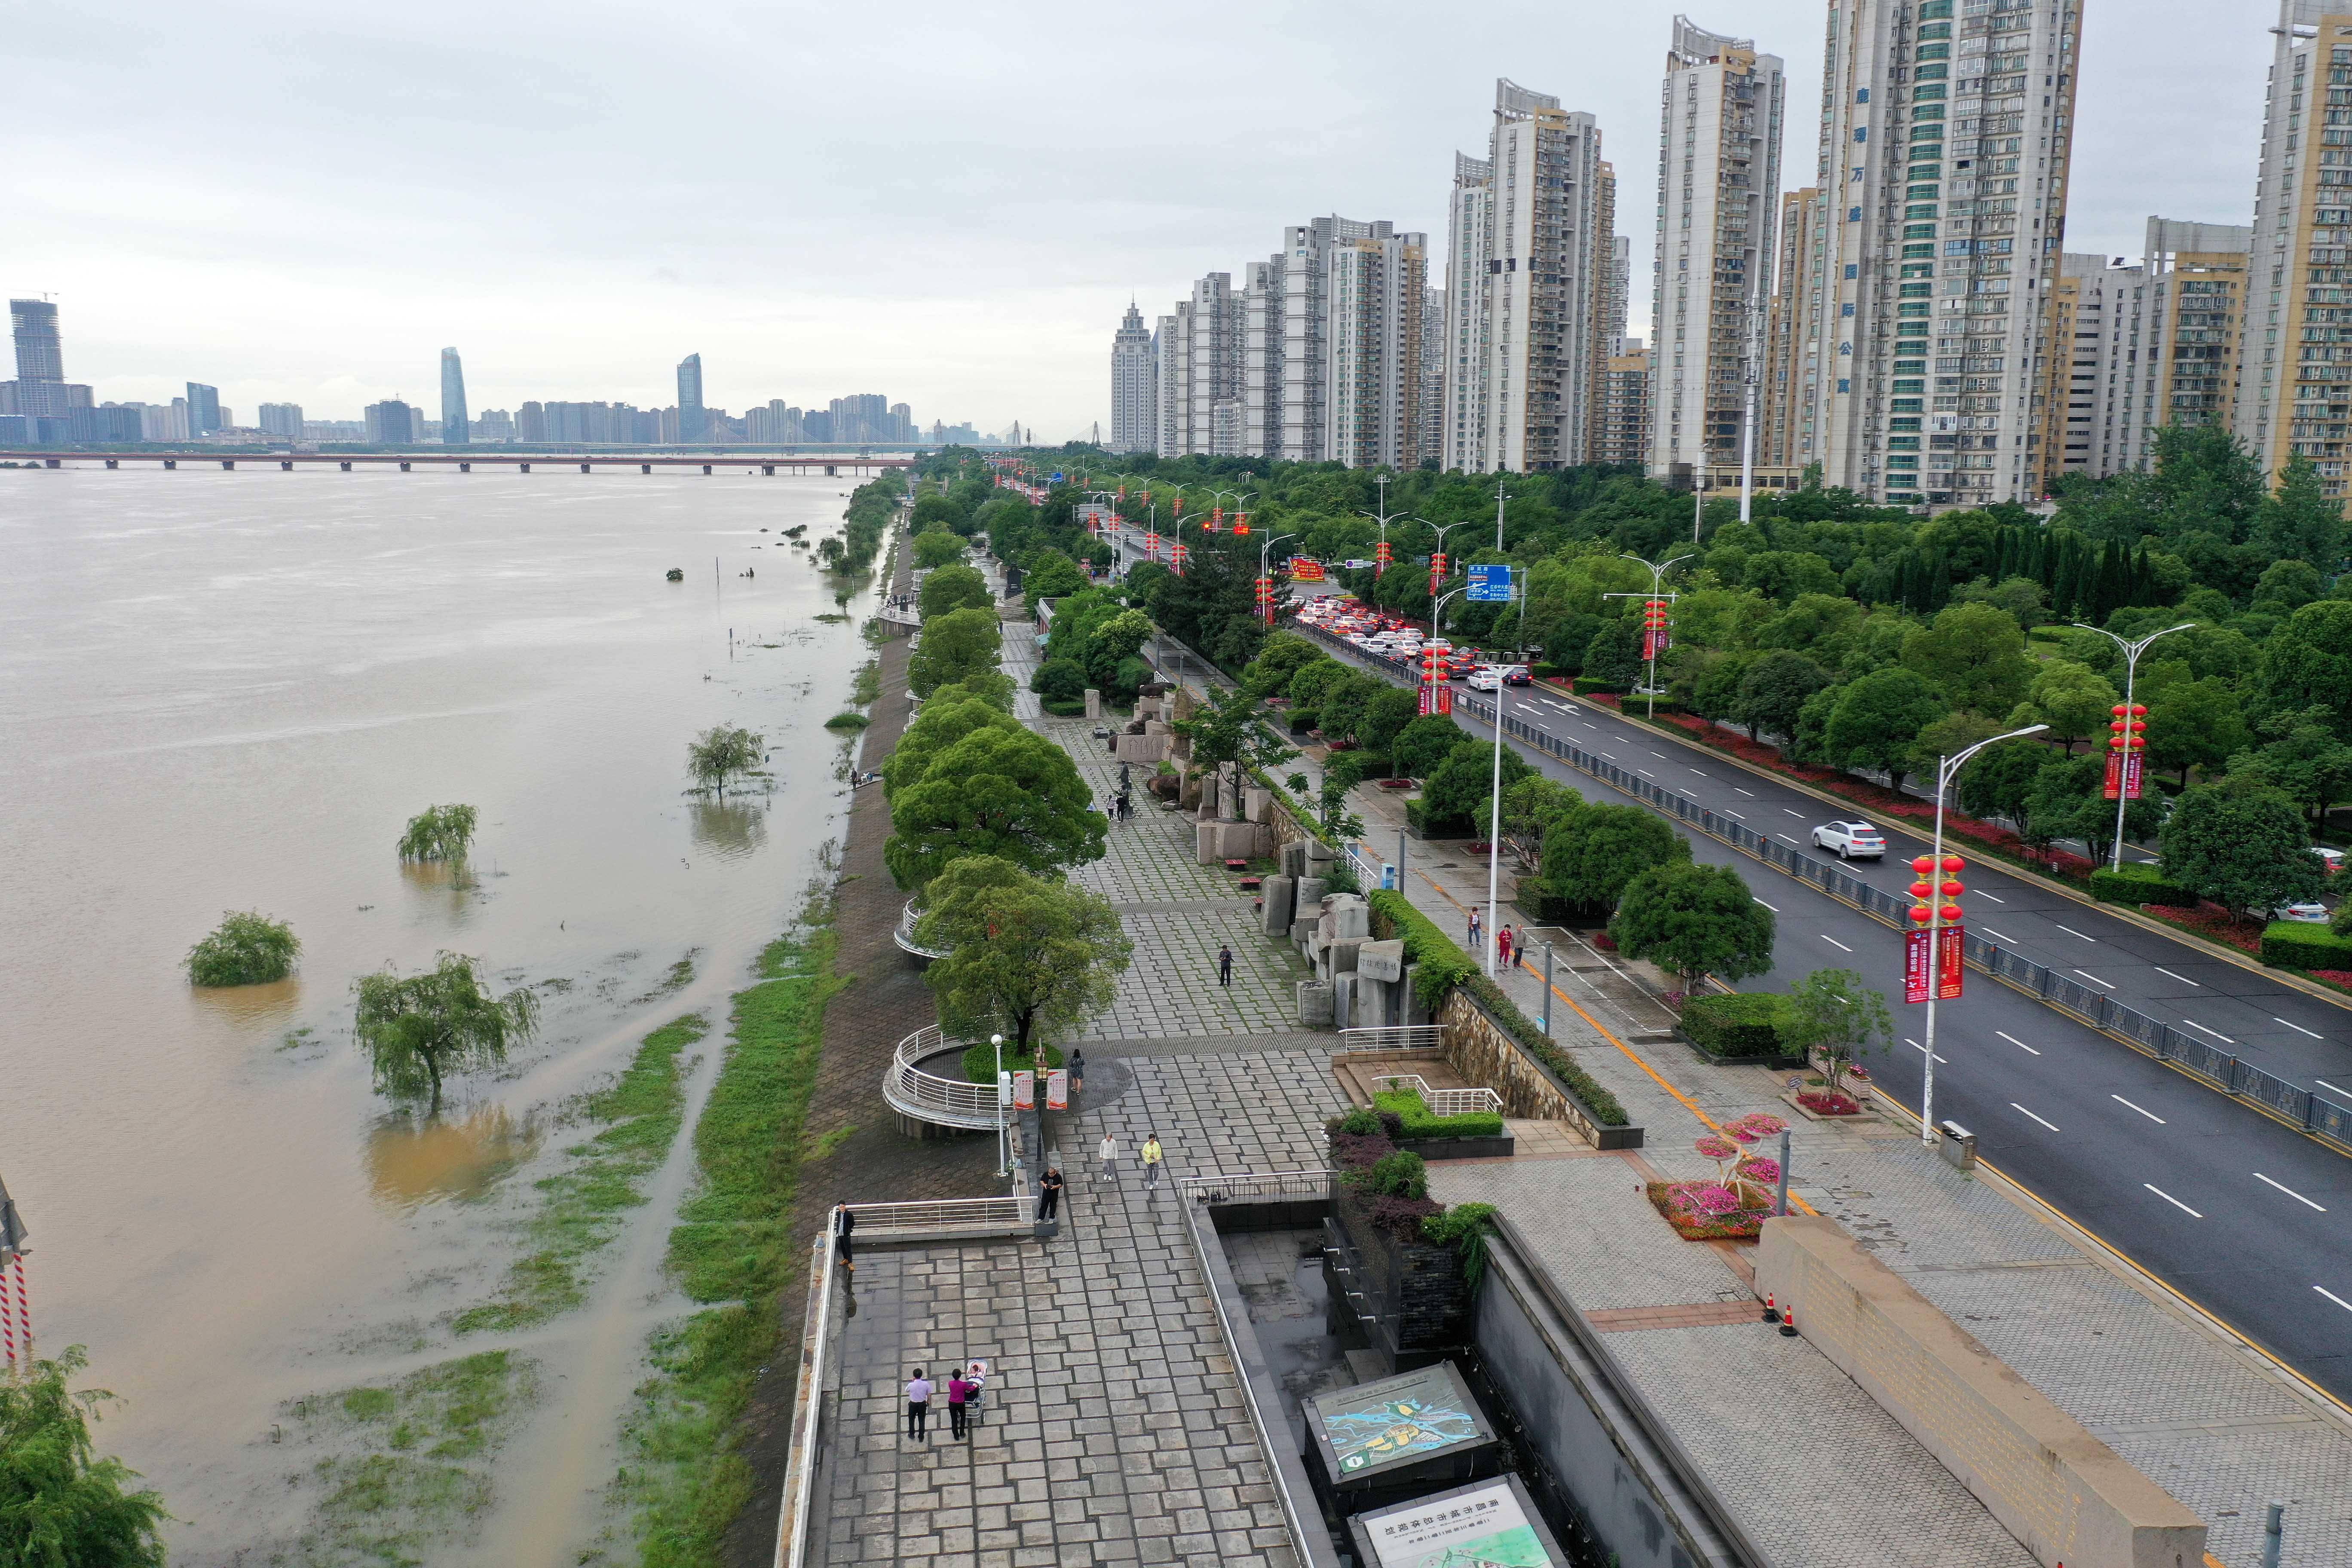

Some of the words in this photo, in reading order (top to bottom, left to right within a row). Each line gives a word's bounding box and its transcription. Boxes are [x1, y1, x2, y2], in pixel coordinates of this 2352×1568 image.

[1384, 1499, 1499, 1535] 南昌市城市总体规划
